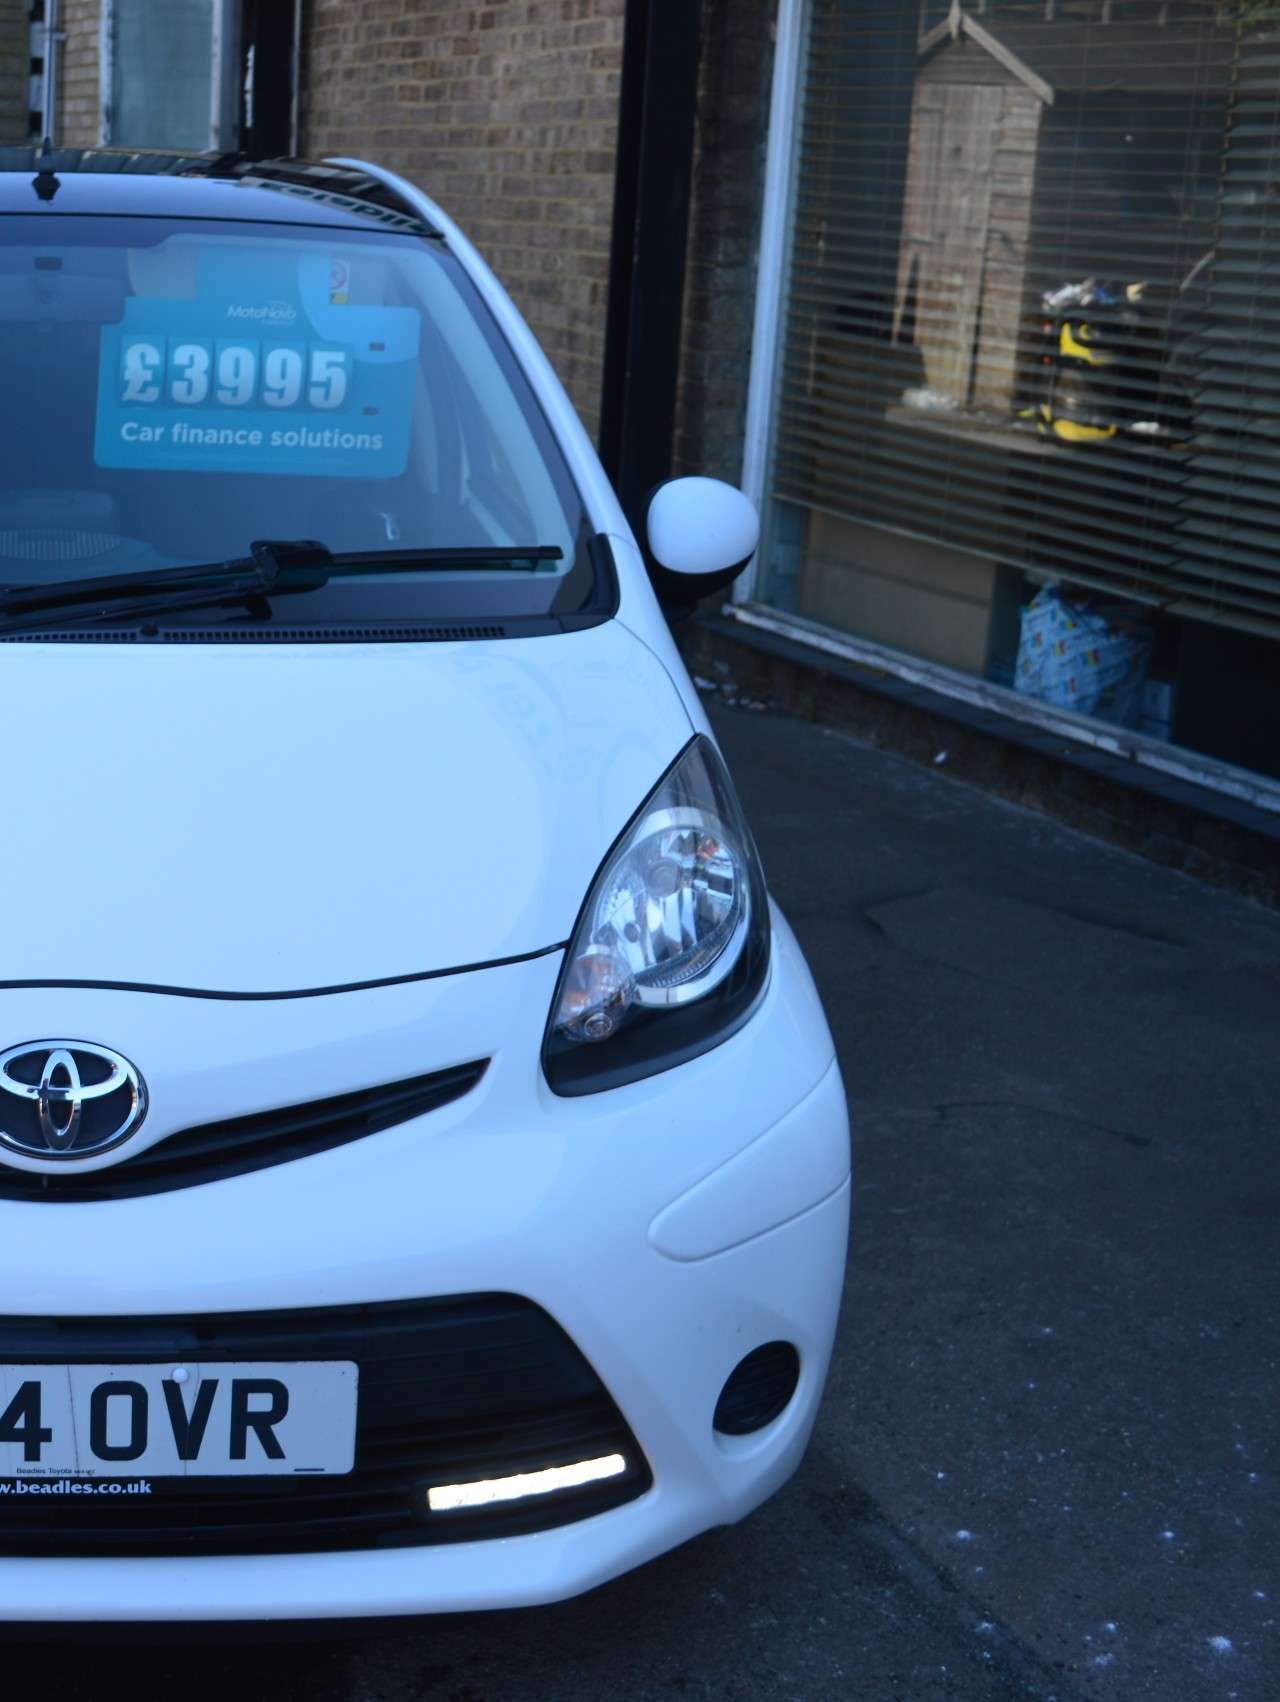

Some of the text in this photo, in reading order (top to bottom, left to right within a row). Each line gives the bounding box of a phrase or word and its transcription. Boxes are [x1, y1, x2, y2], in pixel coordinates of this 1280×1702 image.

[122, 343, 347, 409] £3995
[121, 422, 384, 450] Car finance solutions
[89, 1378, 289, 1461] OVR
